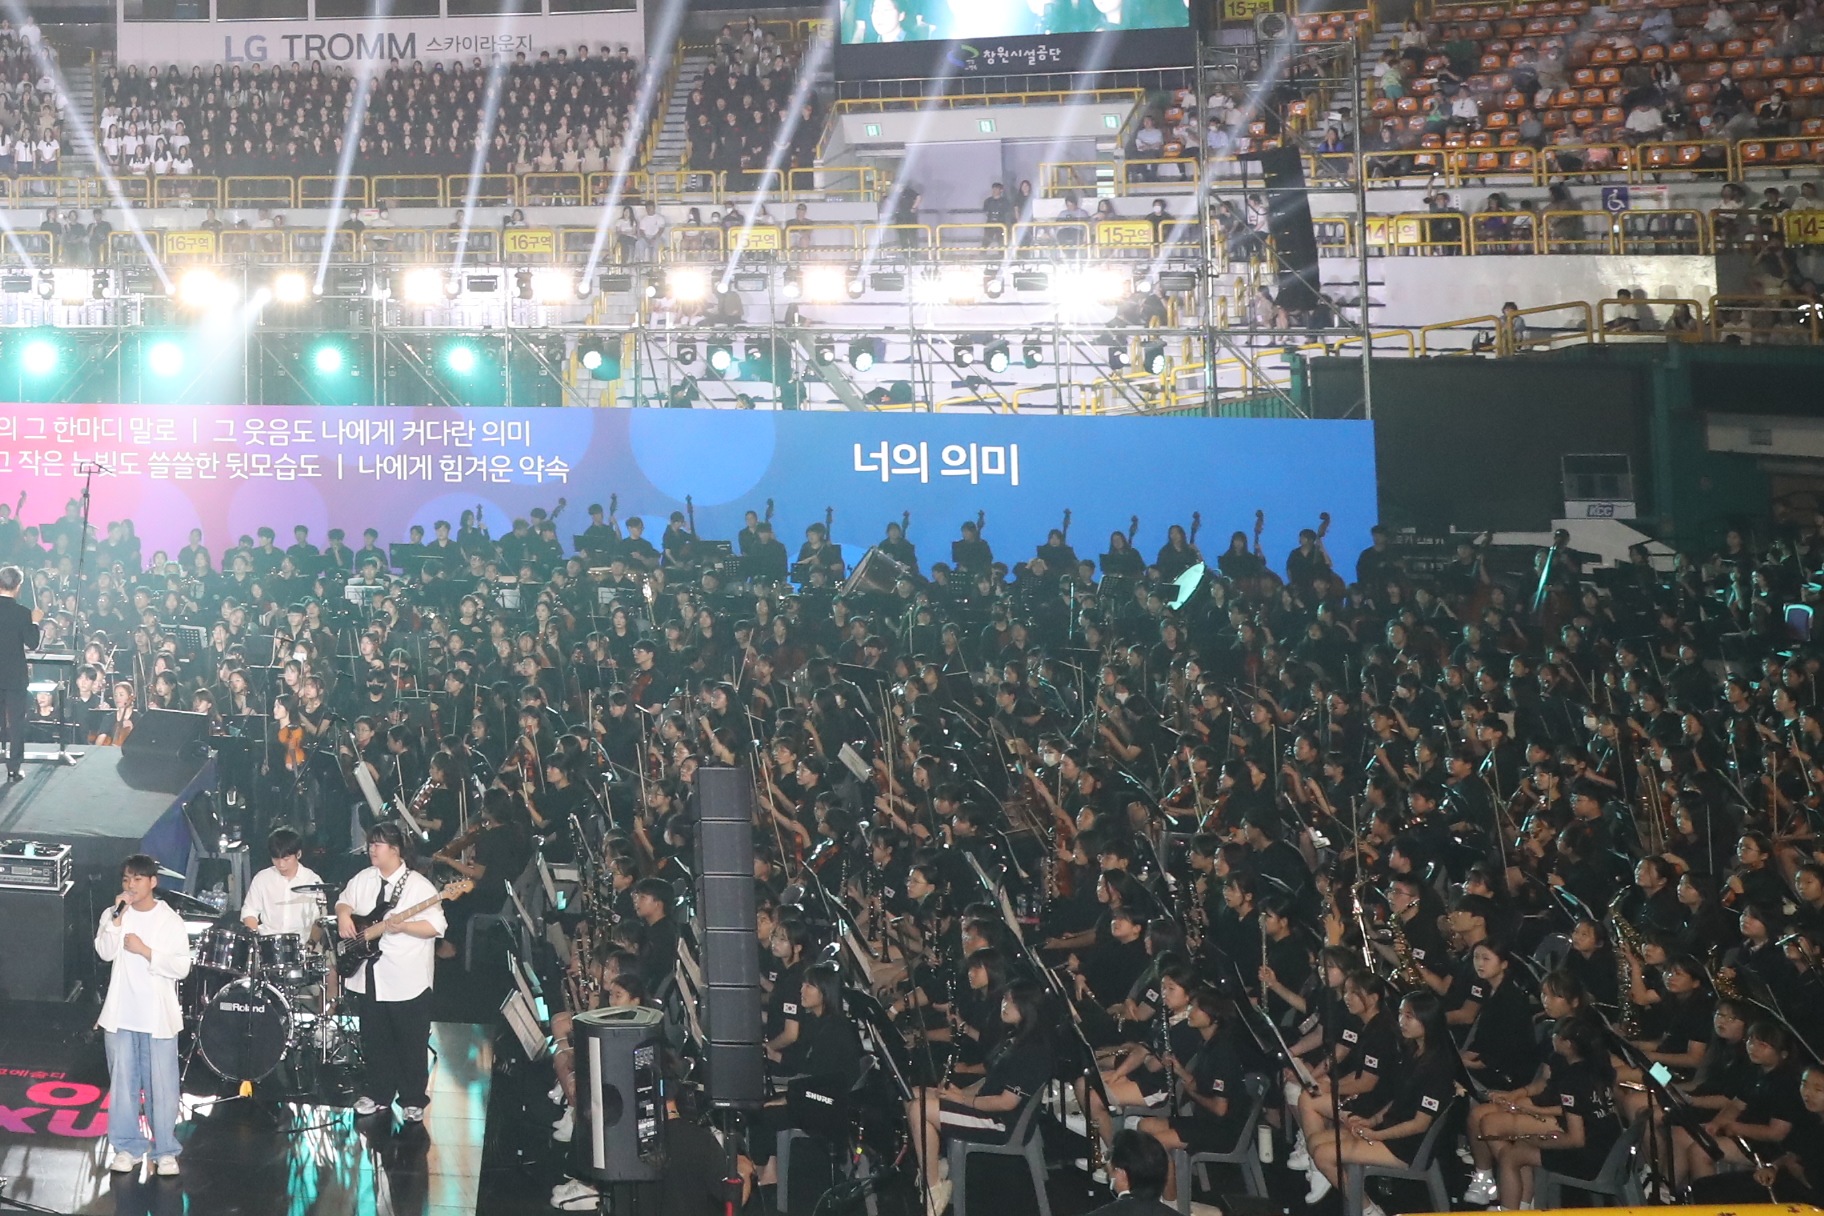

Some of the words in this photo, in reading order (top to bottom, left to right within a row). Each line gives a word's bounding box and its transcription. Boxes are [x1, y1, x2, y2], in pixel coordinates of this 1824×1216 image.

[226, 34, 268, 62] LG
[280, 32, 417, 62] TROMM
[426, 34, 533, 54] 스카이라운지
[982, 45, 1062, 66] 창원시설공단
[168, 235, 210, 251] 16구역
[509, 234, 552, 251] 16구역
[1103, 226, 1151, 244] 15구역
[23, 417, 47, 439] 그
[53, 416, 123, 443] 한마디
[130, 417, 178, 444] 말로
[213, 419, 237, 442] 그
[242, 418, 316, 447] 웃음도
[321, 418, 394, 446] 나에게
[402, 419, 476, 447] 커다란
[481, 419, 531, 447] 의미
[18, 449, 65, 477] 작은
[70, 450, 140, 478] 눈빛도
[147, 450, 220, 480] 쓸쓸한
[225, 451, 323, 481] 뒷모습도
[358, 453, 432, 481] 나에게
[439, 454, 514, 484] 힘겨운
[518, 454, 571, 484] 약속
[853, 440, 929, 484] 너의
[940, 442, 1019, 486] 의미
[1588, 505, 1614, 517] KCC
[26, 1081, 110, 1110] O
[805, 1090, 835, 1106] SHURE
